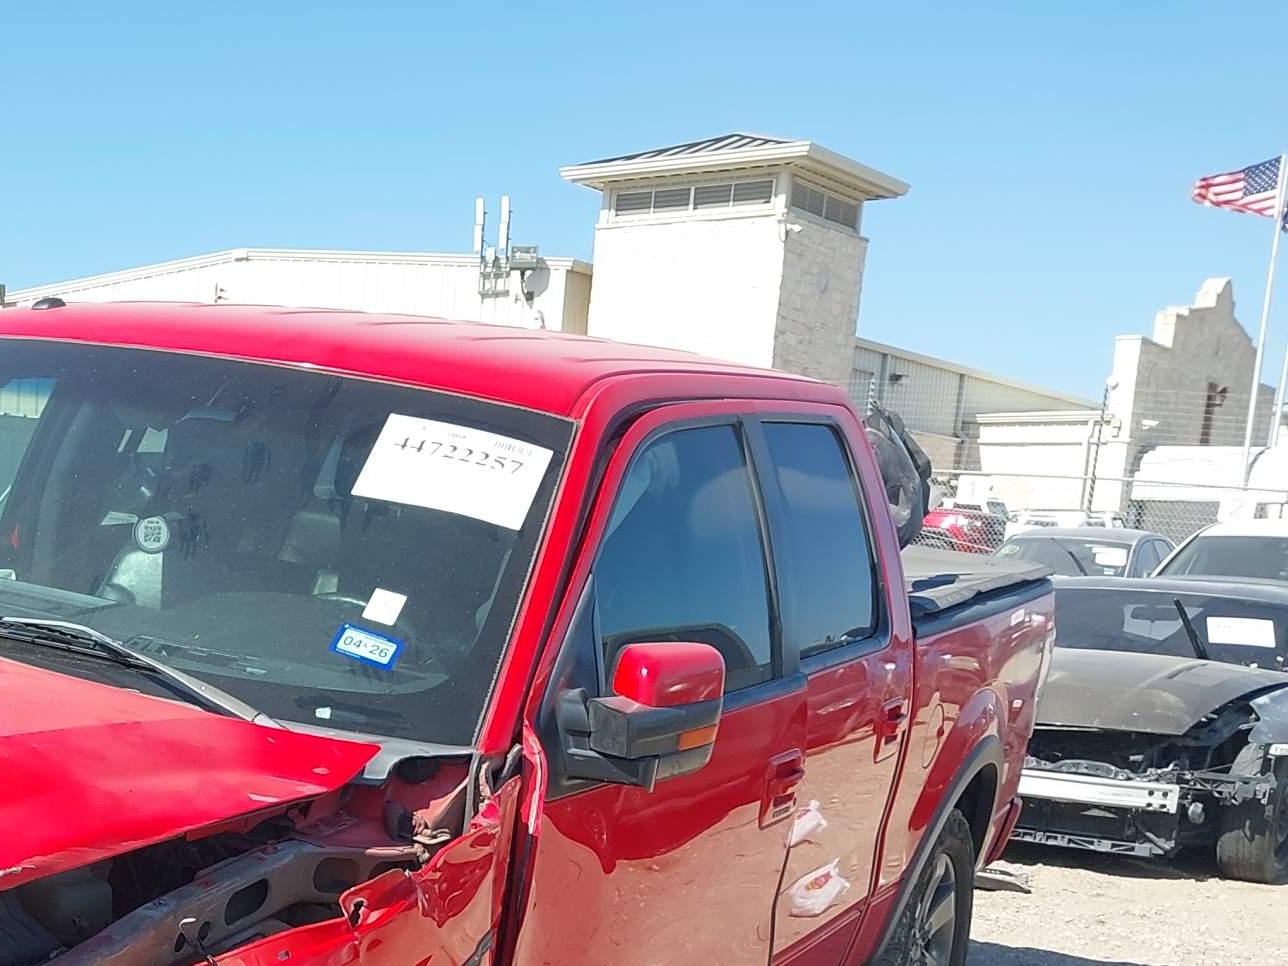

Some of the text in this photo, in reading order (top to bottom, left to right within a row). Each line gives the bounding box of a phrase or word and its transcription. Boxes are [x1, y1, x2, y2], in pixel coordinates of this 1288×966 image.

[394, 436, 524, 475] 44722257
[343, 635, 363, 649] 04
[368, 644, 390, 658] 26
